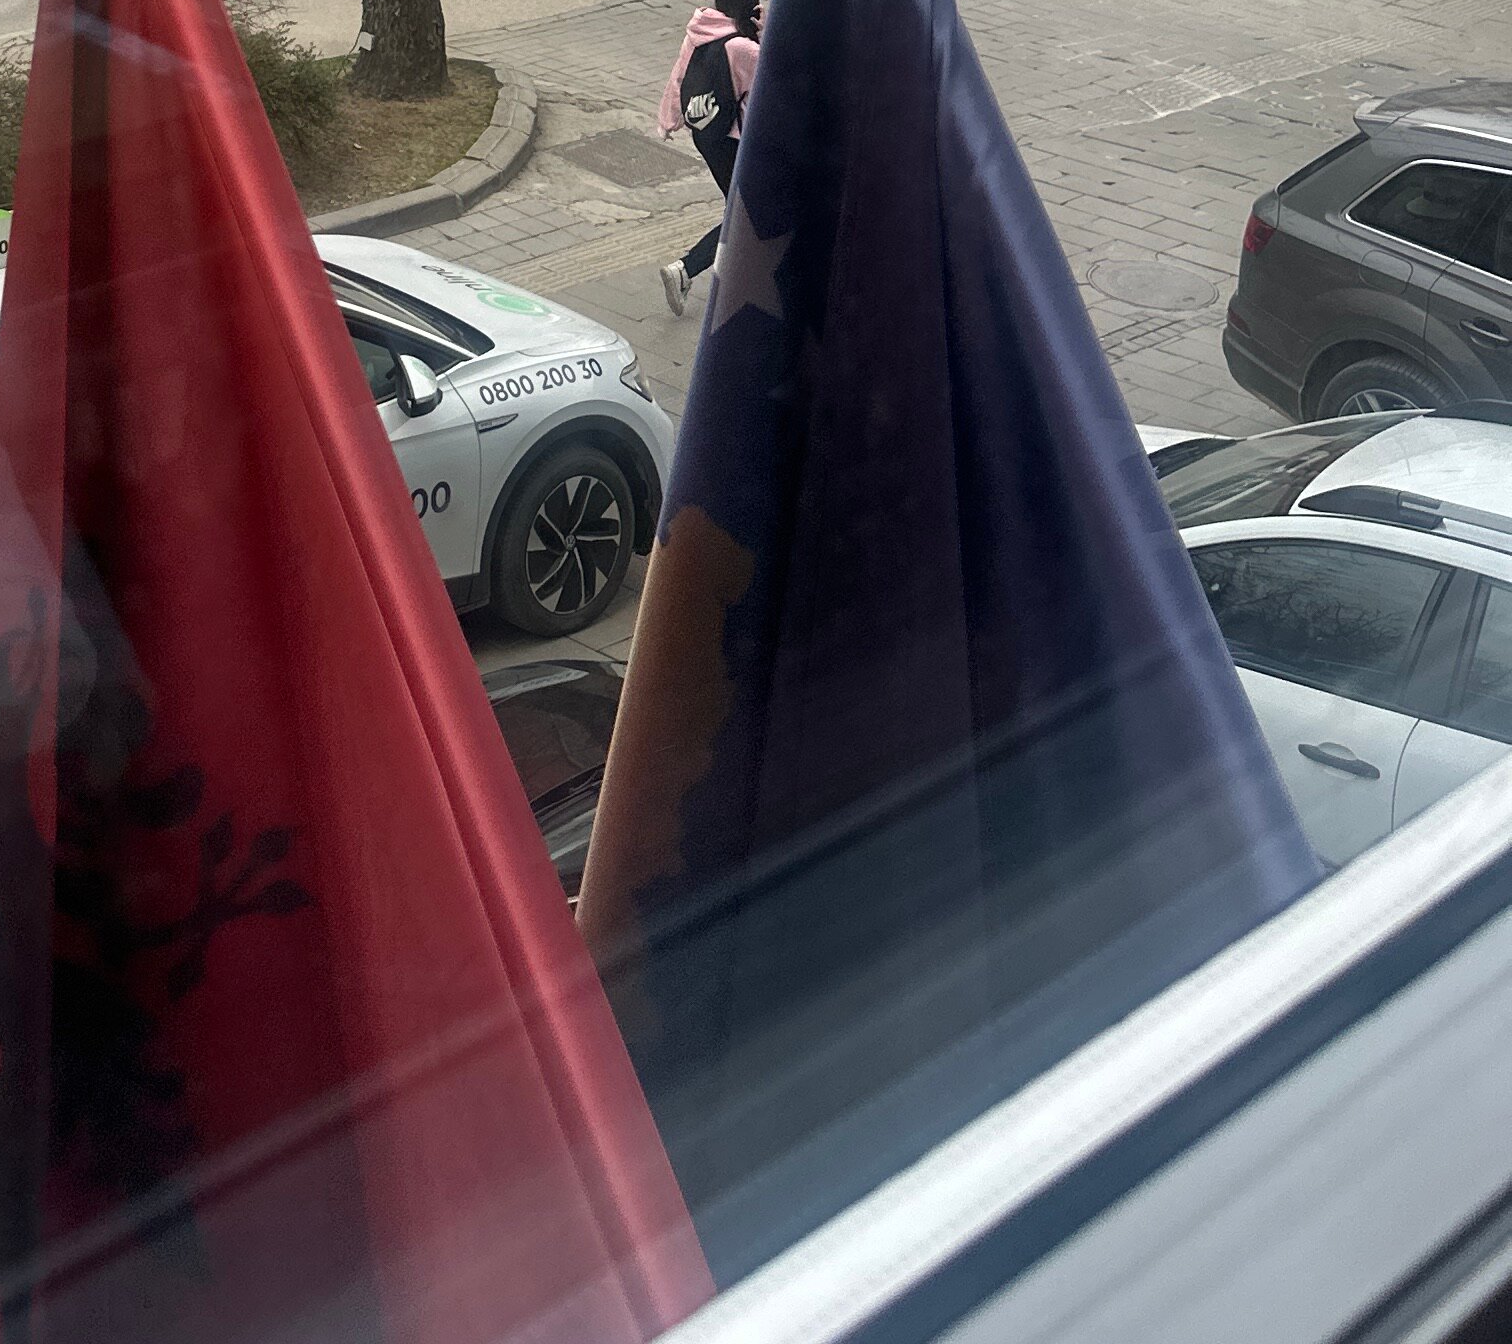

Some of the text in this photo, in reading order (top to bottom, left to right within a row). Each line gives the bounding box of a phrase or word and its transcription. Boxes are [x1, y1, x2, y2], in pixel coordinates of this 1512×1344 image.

[479, 358, 603, 405] 0800 200 30
